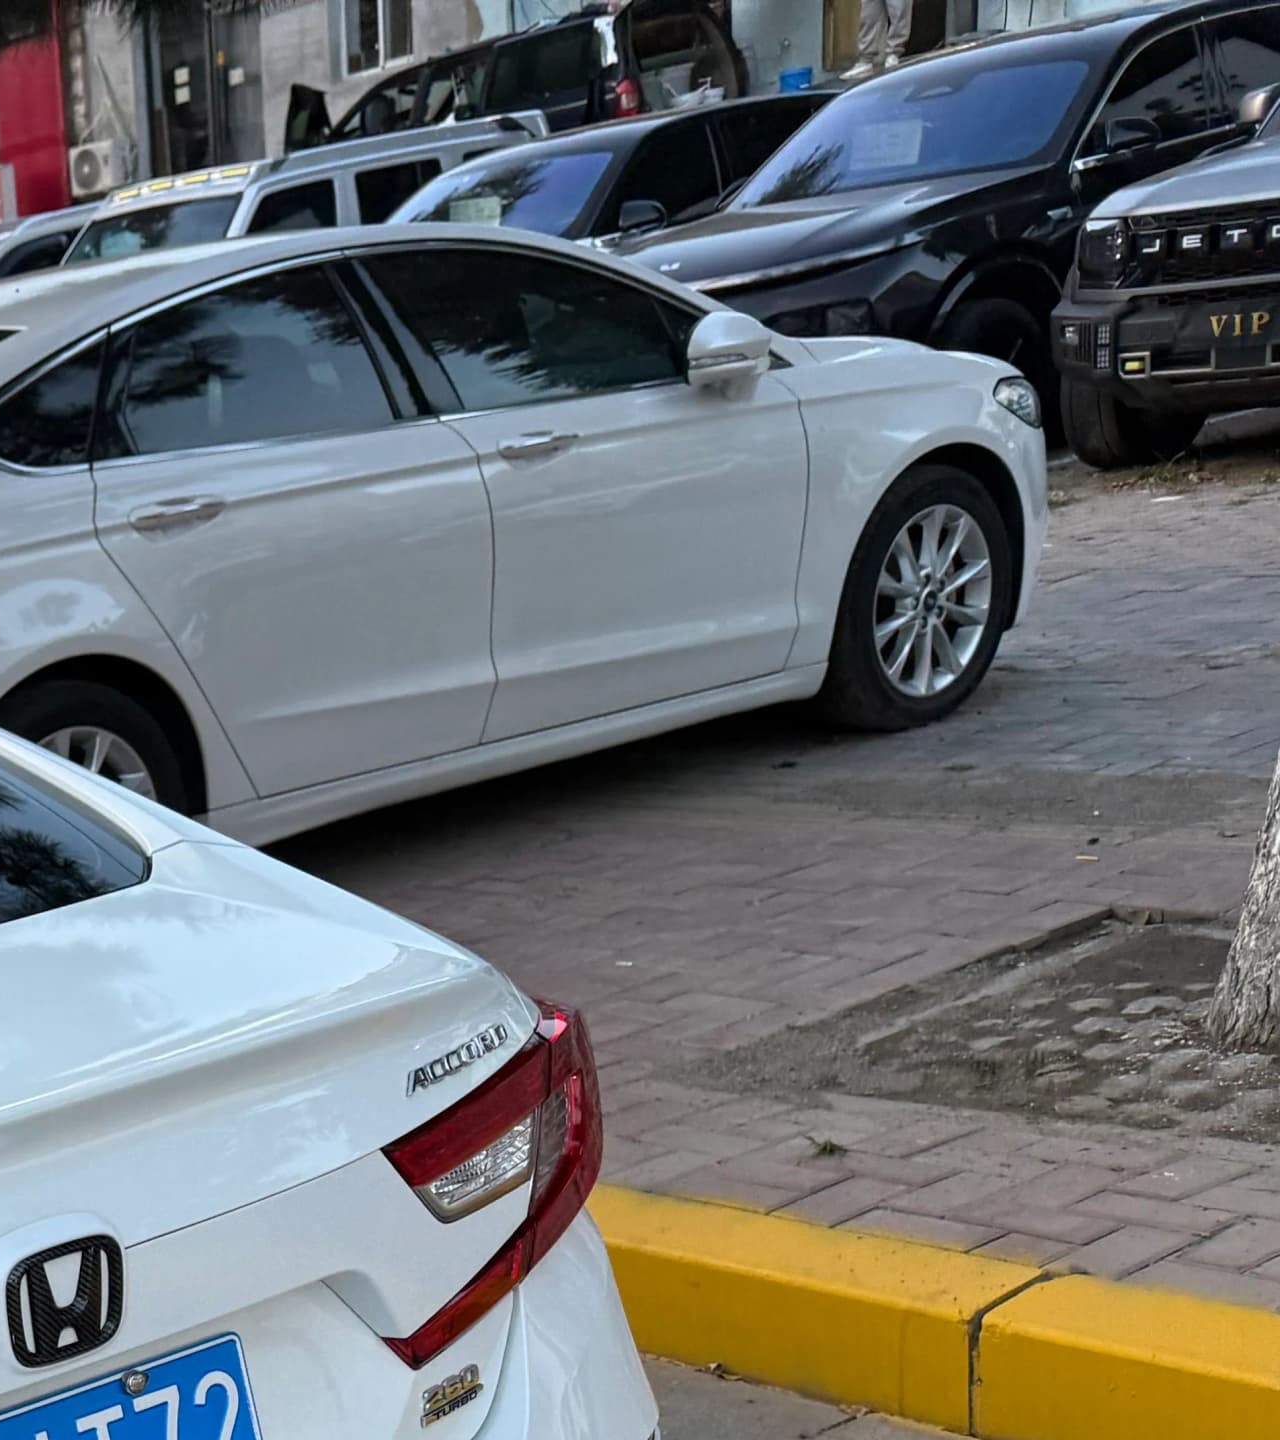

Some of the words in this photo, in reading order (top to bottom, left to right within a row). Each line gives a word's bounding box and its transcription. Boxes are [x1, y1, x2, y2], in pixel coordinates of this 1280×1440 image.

[1209, 311, 1272, 338] VIP
[405, 1023, 509, 1097] ACCORD
[422, 1363, 480, 1413] 260
[432, 1389, 479, 1421] TURBO
